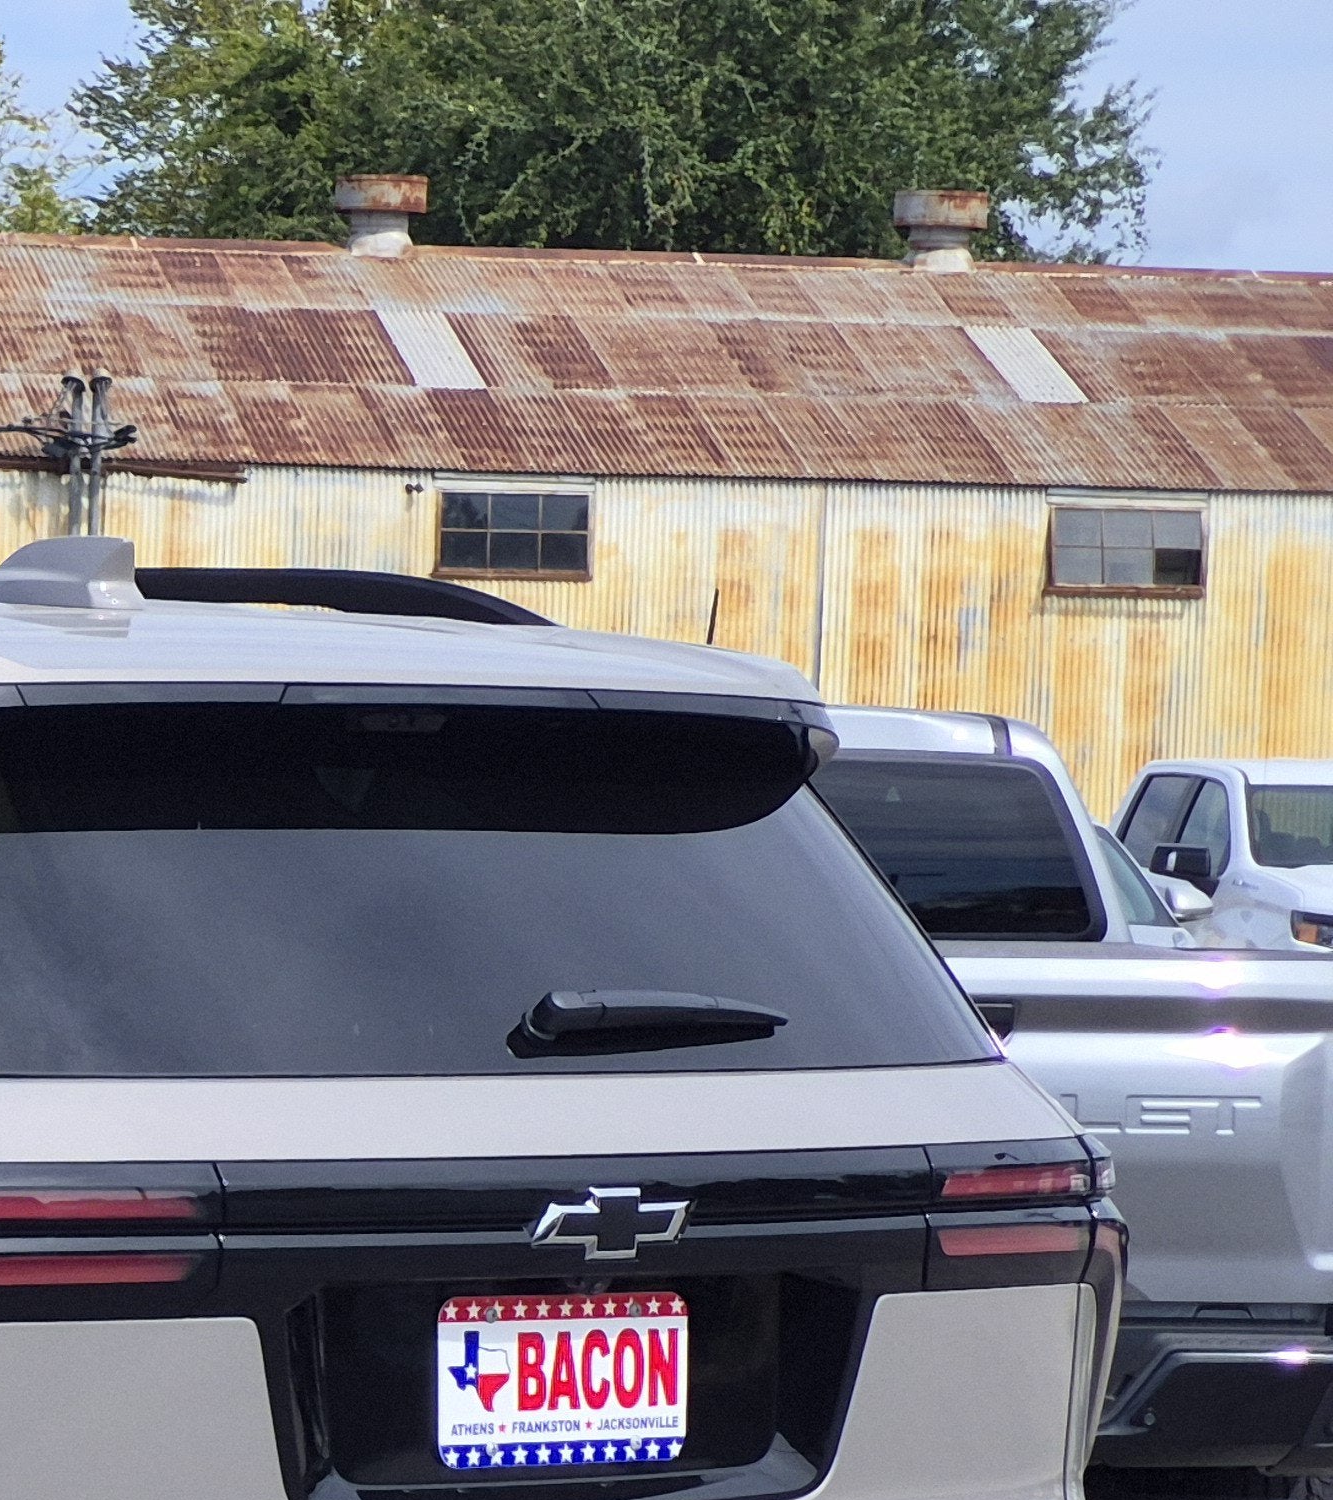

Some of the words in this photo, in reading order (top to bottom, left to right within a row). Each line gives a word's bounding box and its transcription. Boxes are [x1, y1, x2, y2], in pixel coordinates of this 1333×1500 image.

[517, 1327, 679, 1411] BACON
[451, 1422, 495, 1436] ATHENS
[511, 1419, 581, 1433] FRANKSTON
